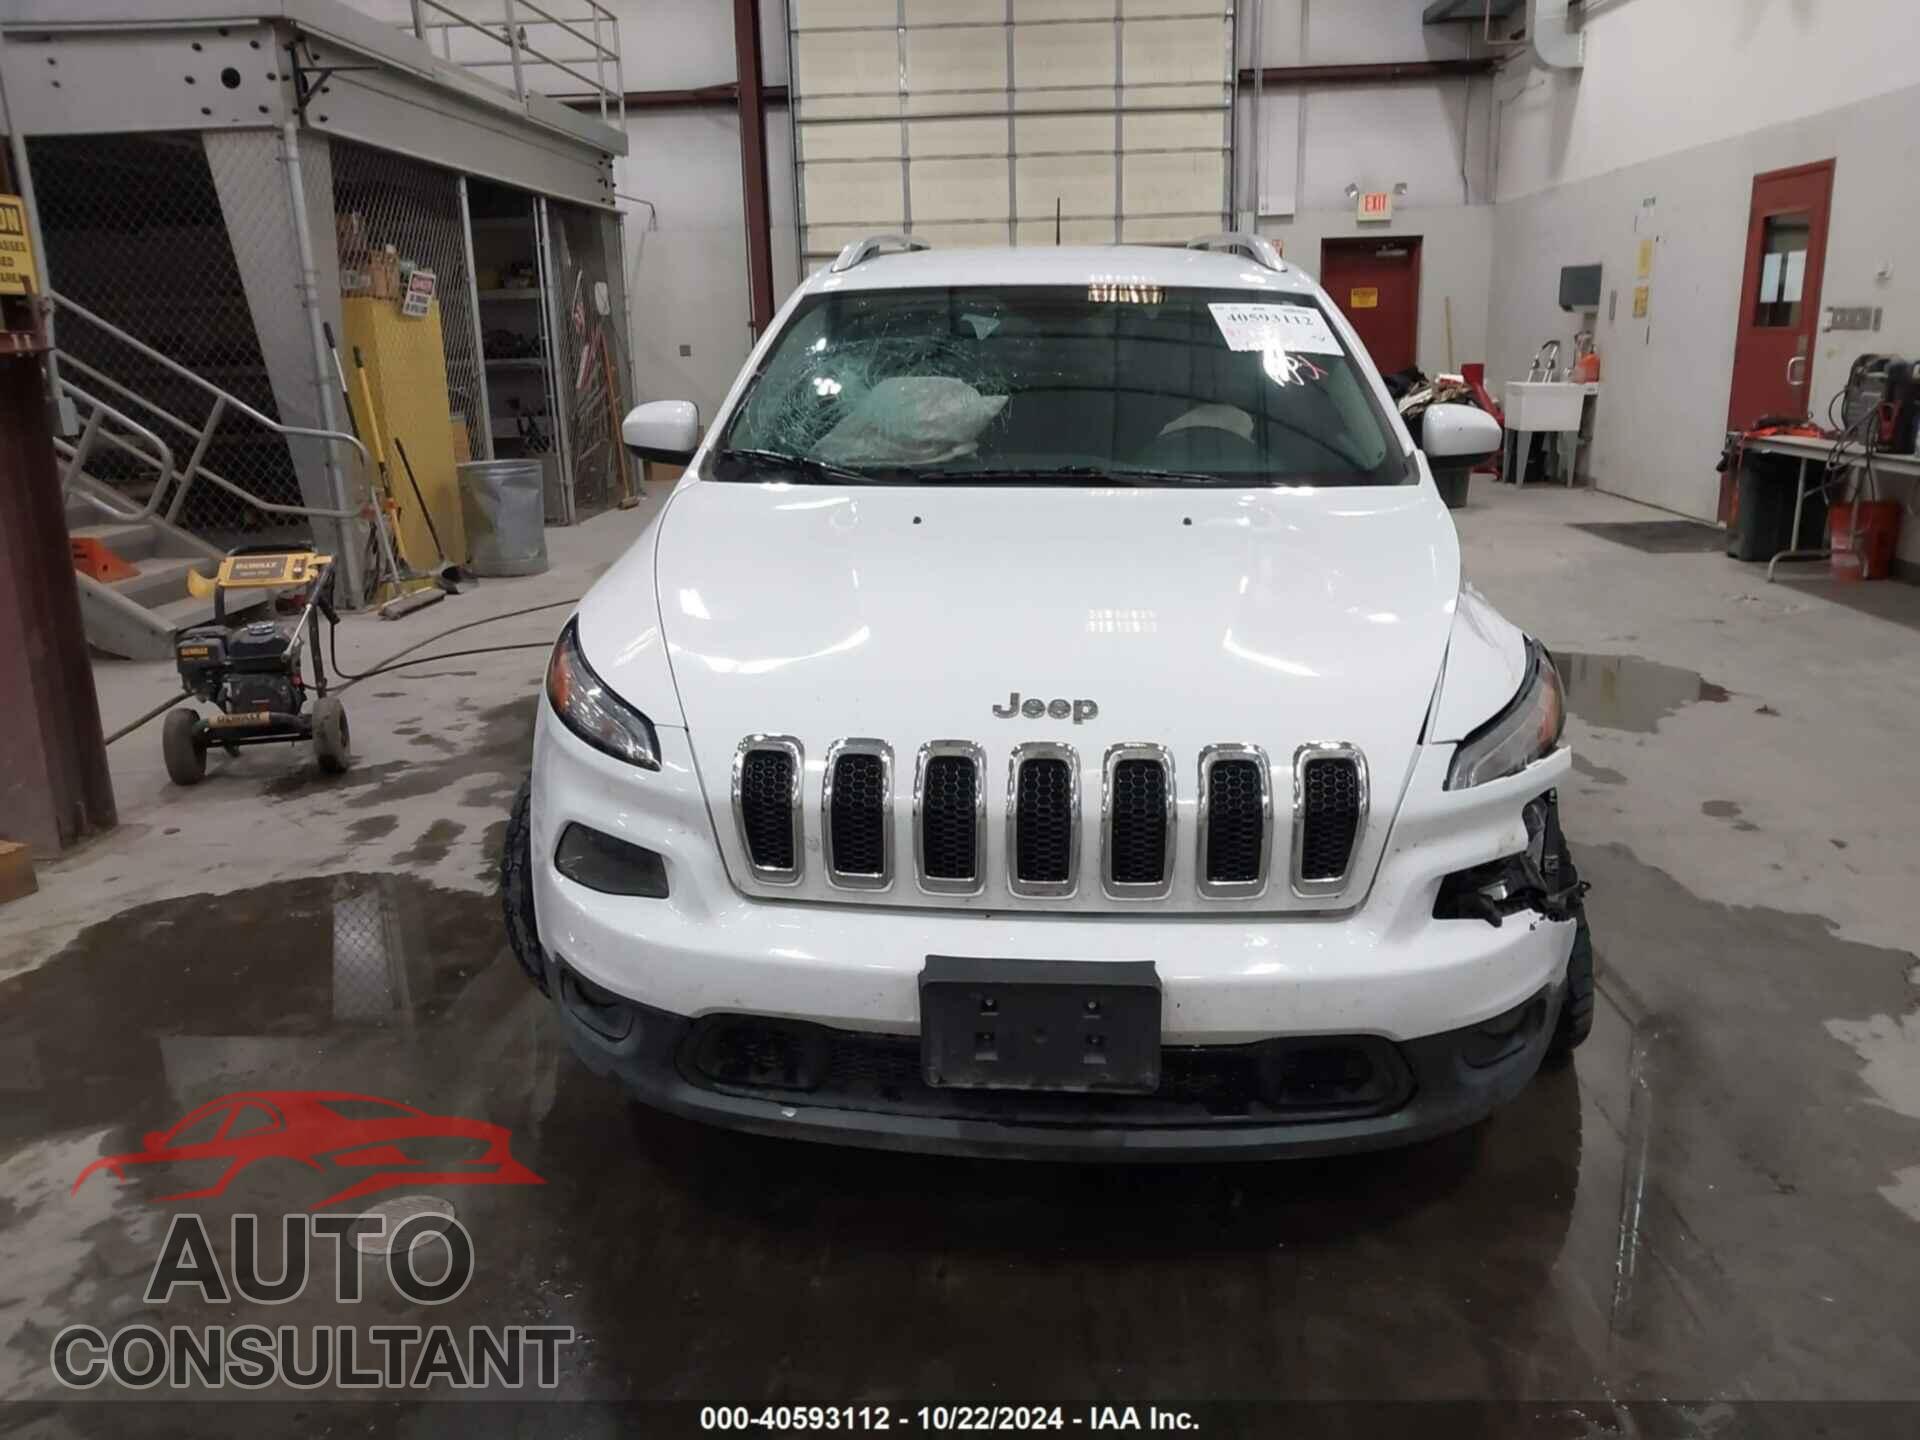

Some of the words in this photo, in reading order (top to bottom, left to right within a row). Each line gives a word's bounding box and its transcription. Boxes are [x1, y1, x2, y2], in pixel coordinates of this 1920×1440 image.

[1364, 194, 1386, 211] EXIT
[1227, 312, 1314, 326] 40593112
[992, 692, 1099, 725] Jeep
